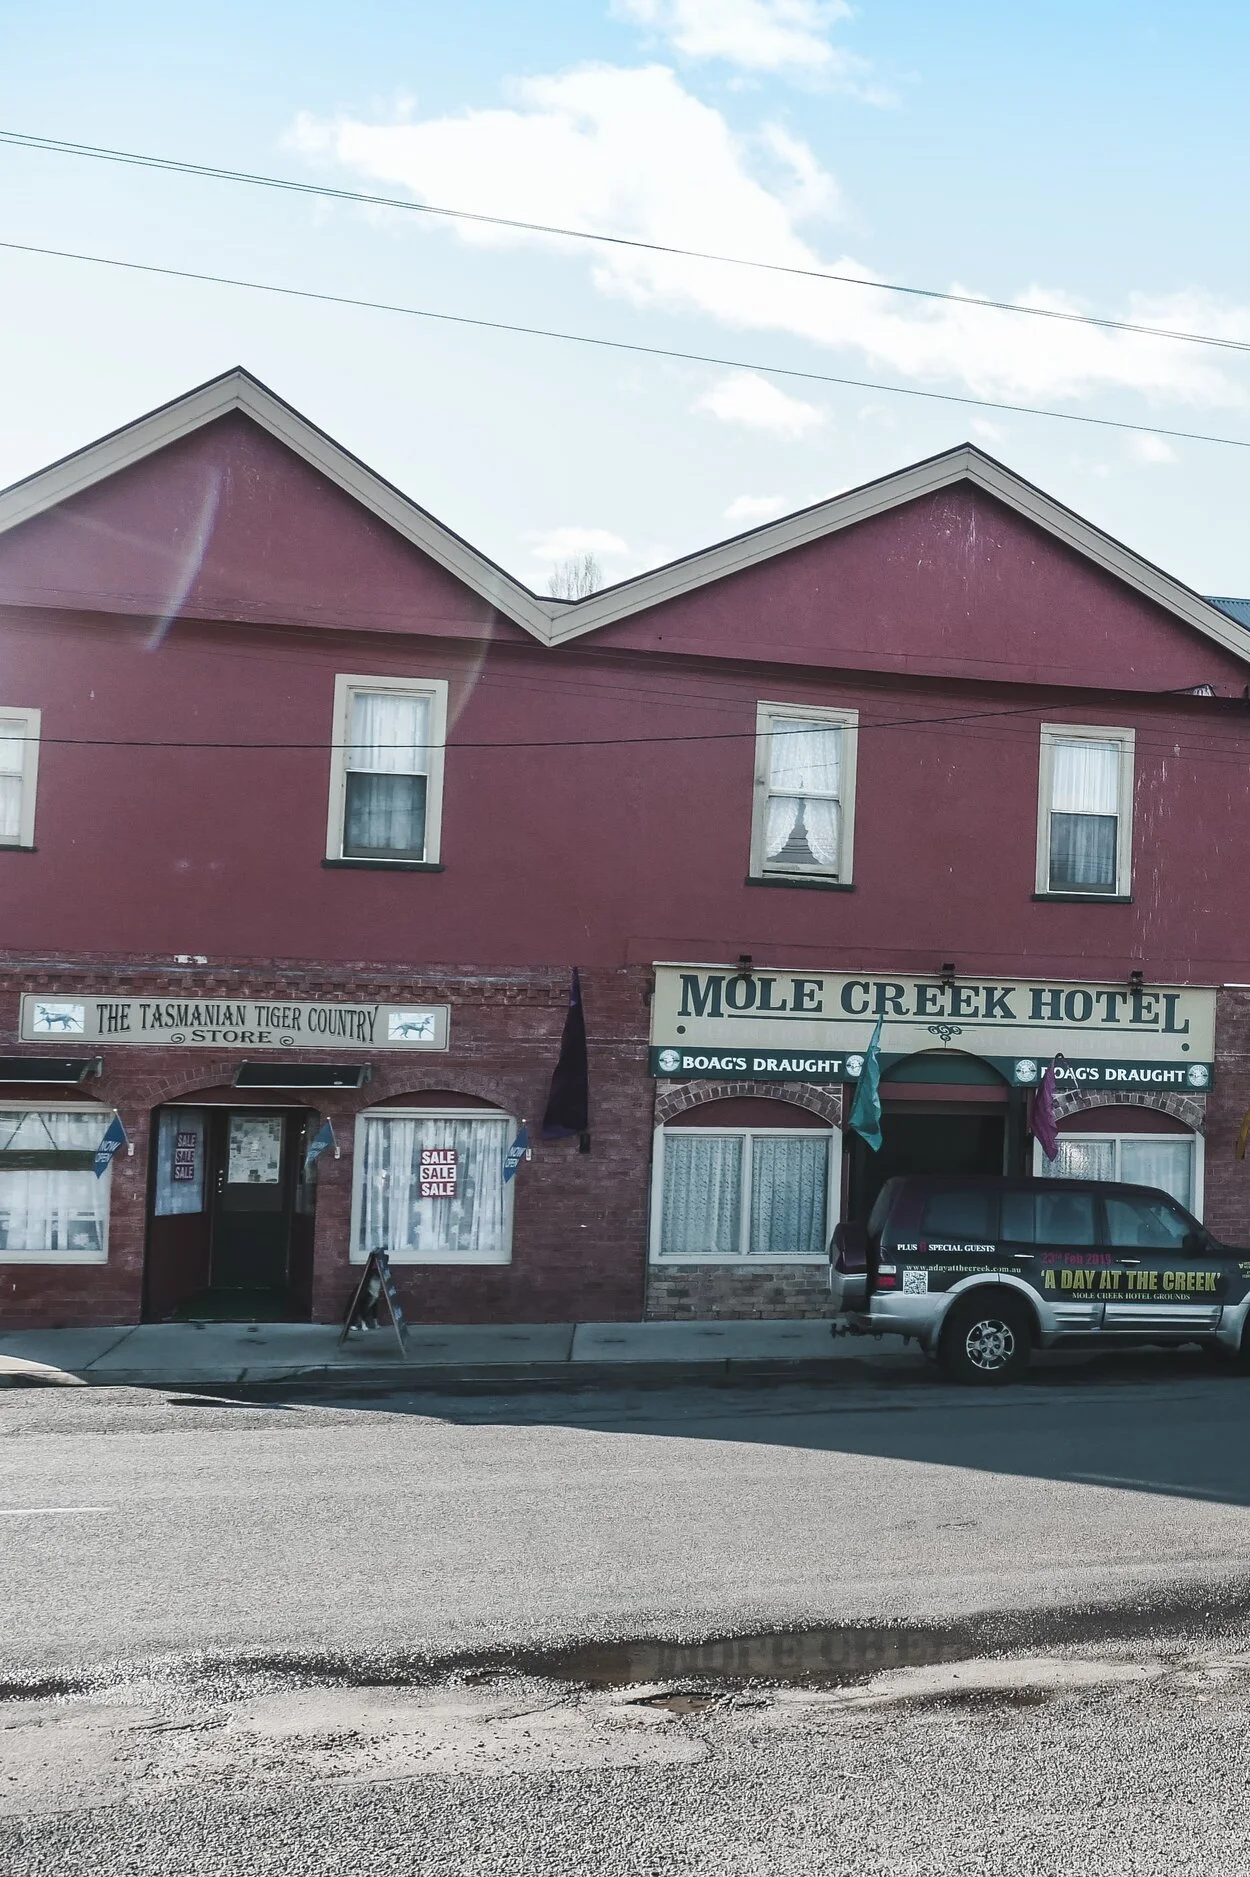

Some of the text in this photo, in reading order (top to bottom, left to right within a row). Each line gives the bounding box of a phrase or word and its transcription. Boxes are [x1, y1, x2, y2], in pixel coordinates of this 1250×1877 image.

[678, 974, 1190, 1034] MOLE CREEK HOTEL
[97, 1003, 379, 1044] THE TASMANIAN TIGER COUNTRY
[191, 1030, 272, 1043] STORE
[682, 1056, 842, 1074] BOAG'S DRAUGHT
[1104, 1068, 1186, 1084] DRAUGHT
[177, 1134, 196, 1147] SALE
[176, 1150, 194, 1163] SALE
[421, 1151, 455, 1165] SALE
[175, 1166, 193, 1179] SALE
[422, 1167, 454, 1180] SALE
[421, 1183, 455, 1196] SALE
[928, 1244, 963, 1252] SPECIAL
[1060, 1270, 1096, 1289] DAY
[1099, 1270, 1121, 1290] AT
[1126, 1271, 1158, 1290] THE
[1097, 1292, 1123, 1300] CREEK
[1125, 1292, 1152, 1300] HOTEL
